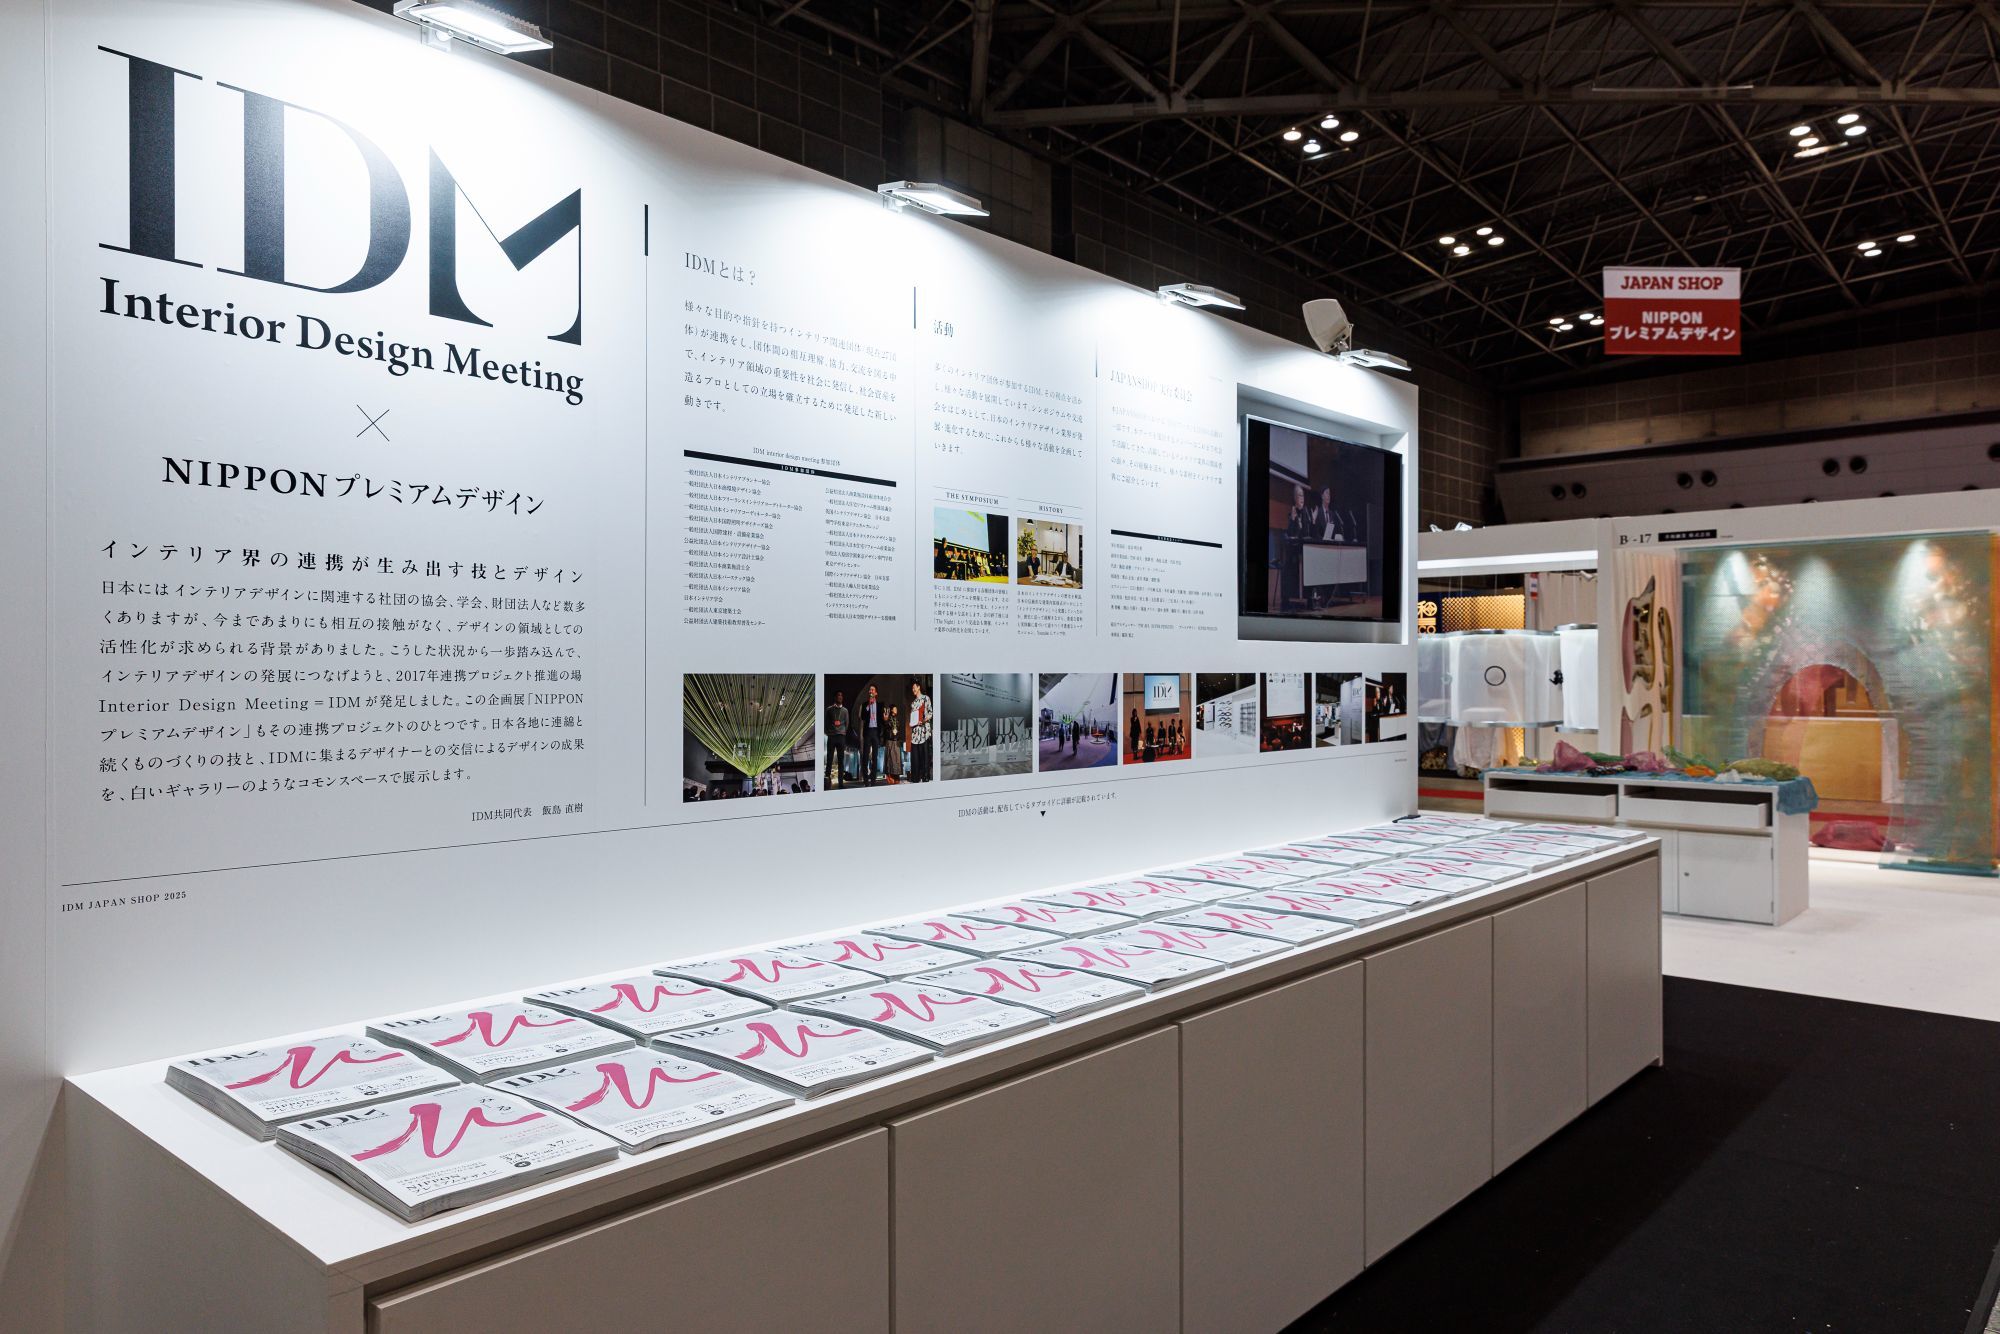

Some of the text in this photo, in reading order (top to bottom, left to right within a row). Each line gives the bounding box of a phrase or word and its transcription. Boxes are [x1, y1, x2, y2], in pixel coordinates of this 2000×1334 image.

[98, 45, 582, 346] IDM
[1621, 276, 1724, 290] JAPAN SHOP
[1642, 311, 1703, 325] NIPPON
[99, 277, 584, 406] Interior Design Meeting
[1609, 326, 1736, 341] プレミアムデザイン
[684, 395, 727, 413] 動きです。
[961, 493, 999, 505] SYMPOSIUM
[1038, 505, 1064, 514] HISTORY
[101, 540, 583, 583] インテリア界の連携が生み出す技とデザイン
[99, 699, 170, 713] Interior
[179, 698, 236, 713] Design
[245, 697, 309, 711] Meeting
[102, 768, 471, 802] を、白いギャラリーのようなコモンスペースで展示します。
[472, 803, 584, 822] IDM共同代表 飯島 直樹
[61, 891, 187, 912] IDM JAPAN SHOP 2025
